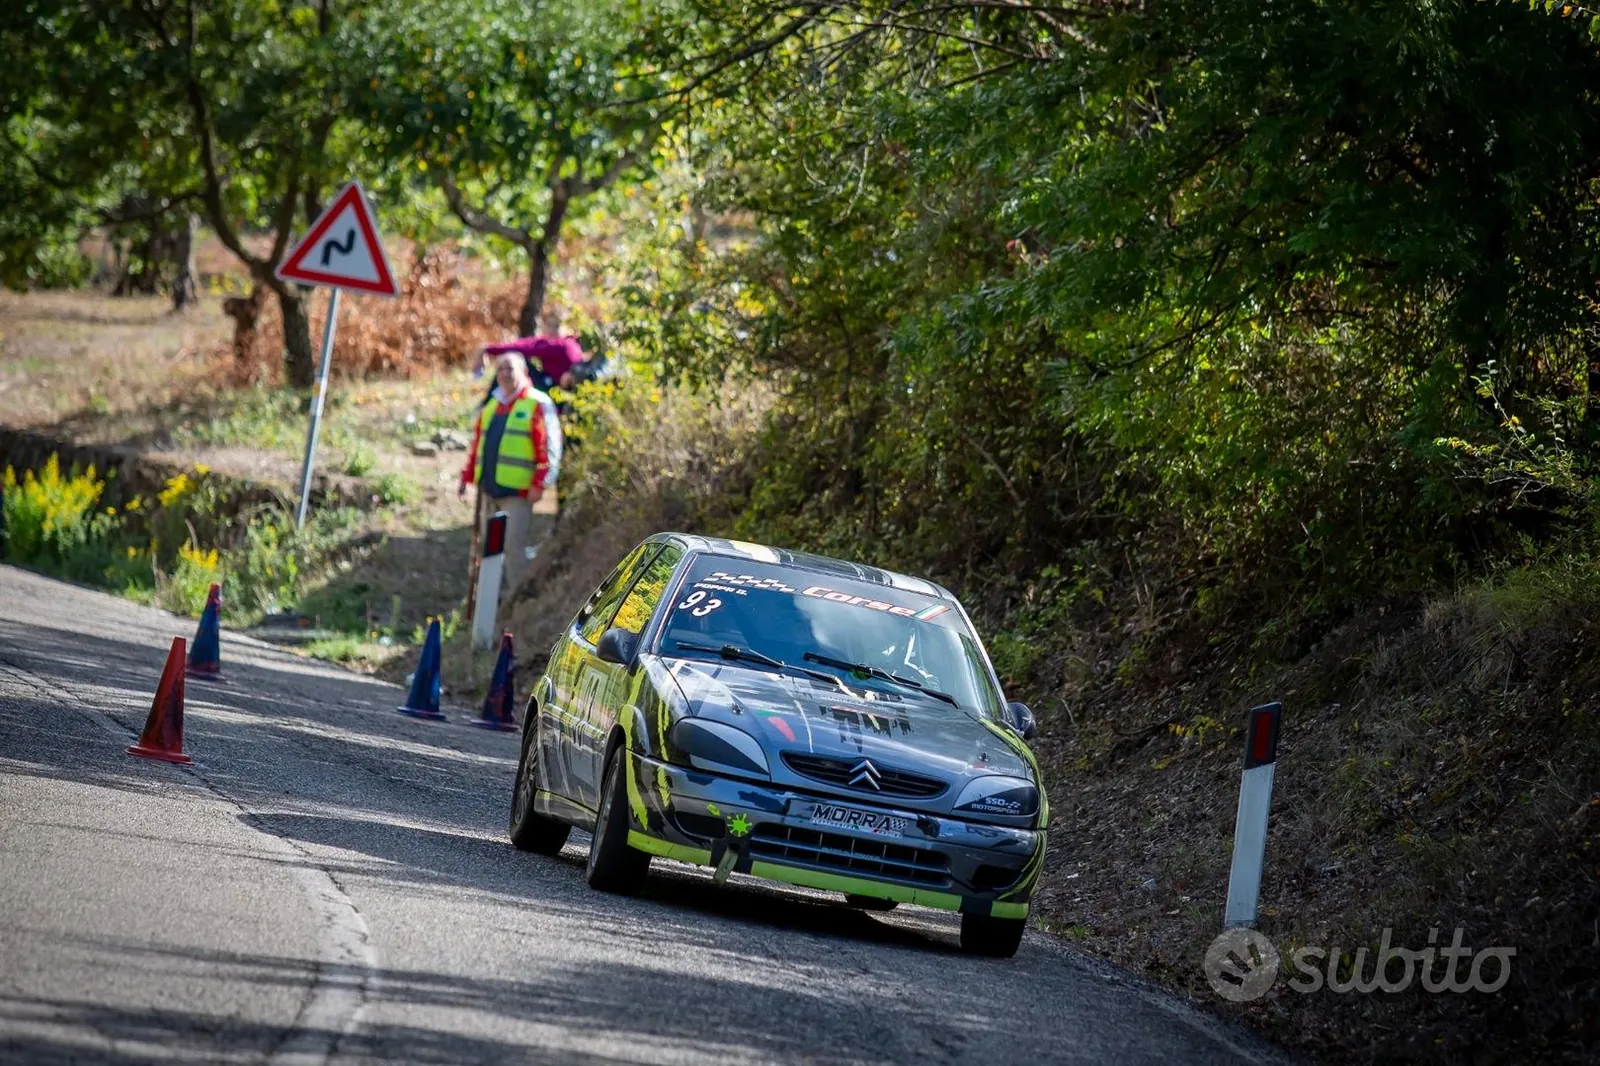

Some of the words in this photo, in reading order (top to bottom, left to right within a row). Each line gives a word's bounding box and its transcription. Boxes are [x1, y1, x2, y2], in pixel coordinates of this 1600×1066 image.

[679, 590, 722, 617] 93
[803, 586, 916, 617] Corse
[812, 803, 891, 831] MORRA
[971, 803, 1020, 815] MOTORSPORT
